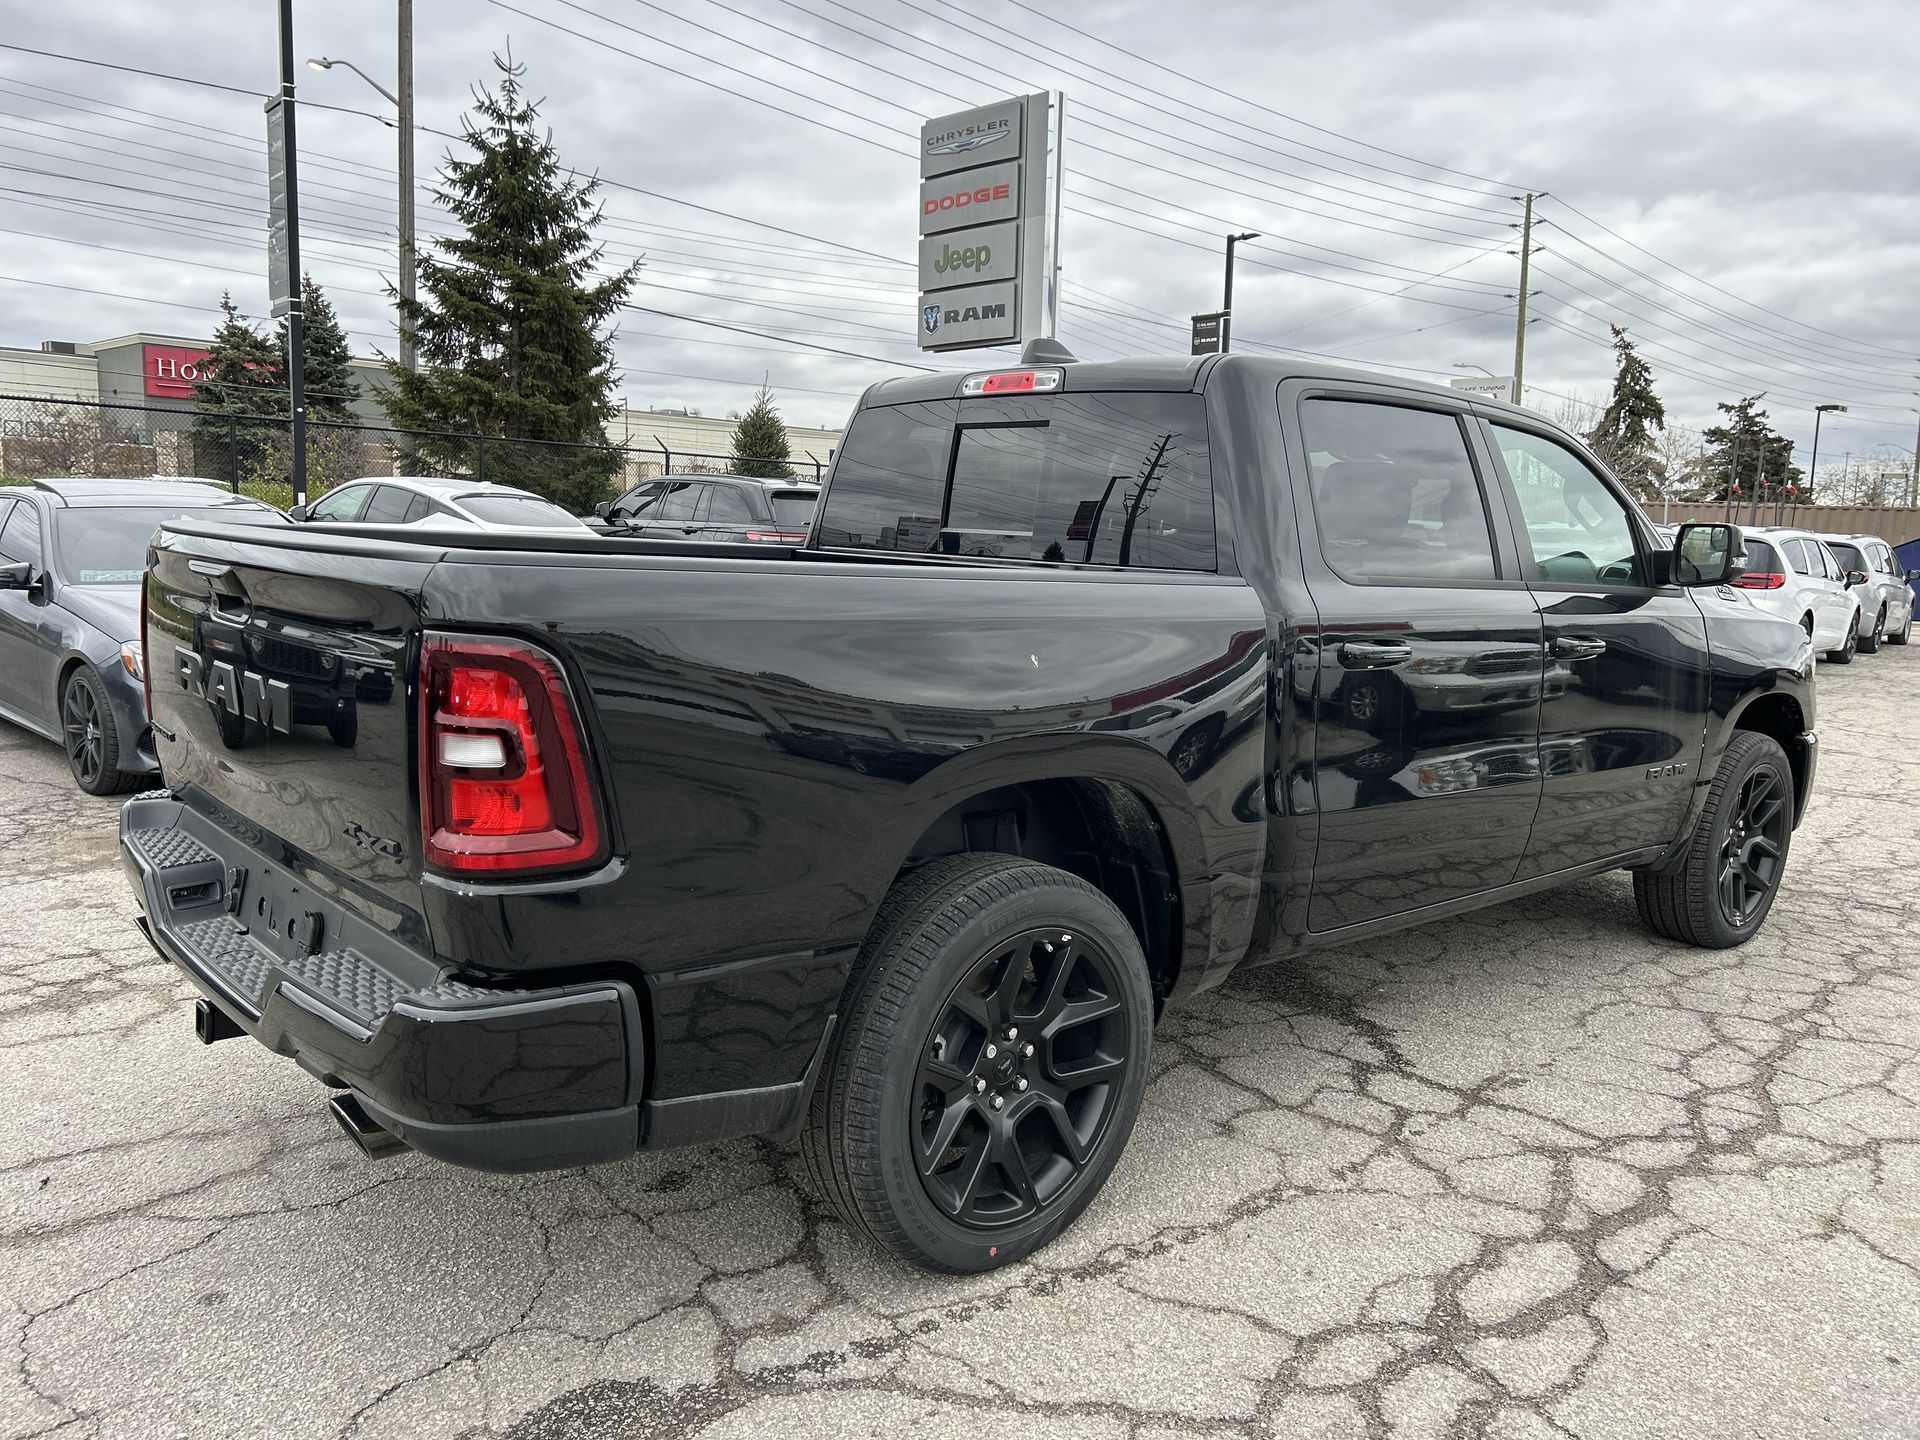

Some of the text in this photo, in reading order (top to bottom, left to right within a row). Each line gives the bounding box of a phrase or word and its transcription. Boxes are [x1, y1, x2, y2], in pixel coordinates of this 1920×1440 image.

[926, 119, 1009, 146] CHRYSLER
[924, 184, 1009, 215] DODGE
[934, 244, 991, 273] Jeep
[944, 303, 1006, 324] RAM
[175, 645, 291, 735] RAM
[1645, 763, 1688, 780] RAM
